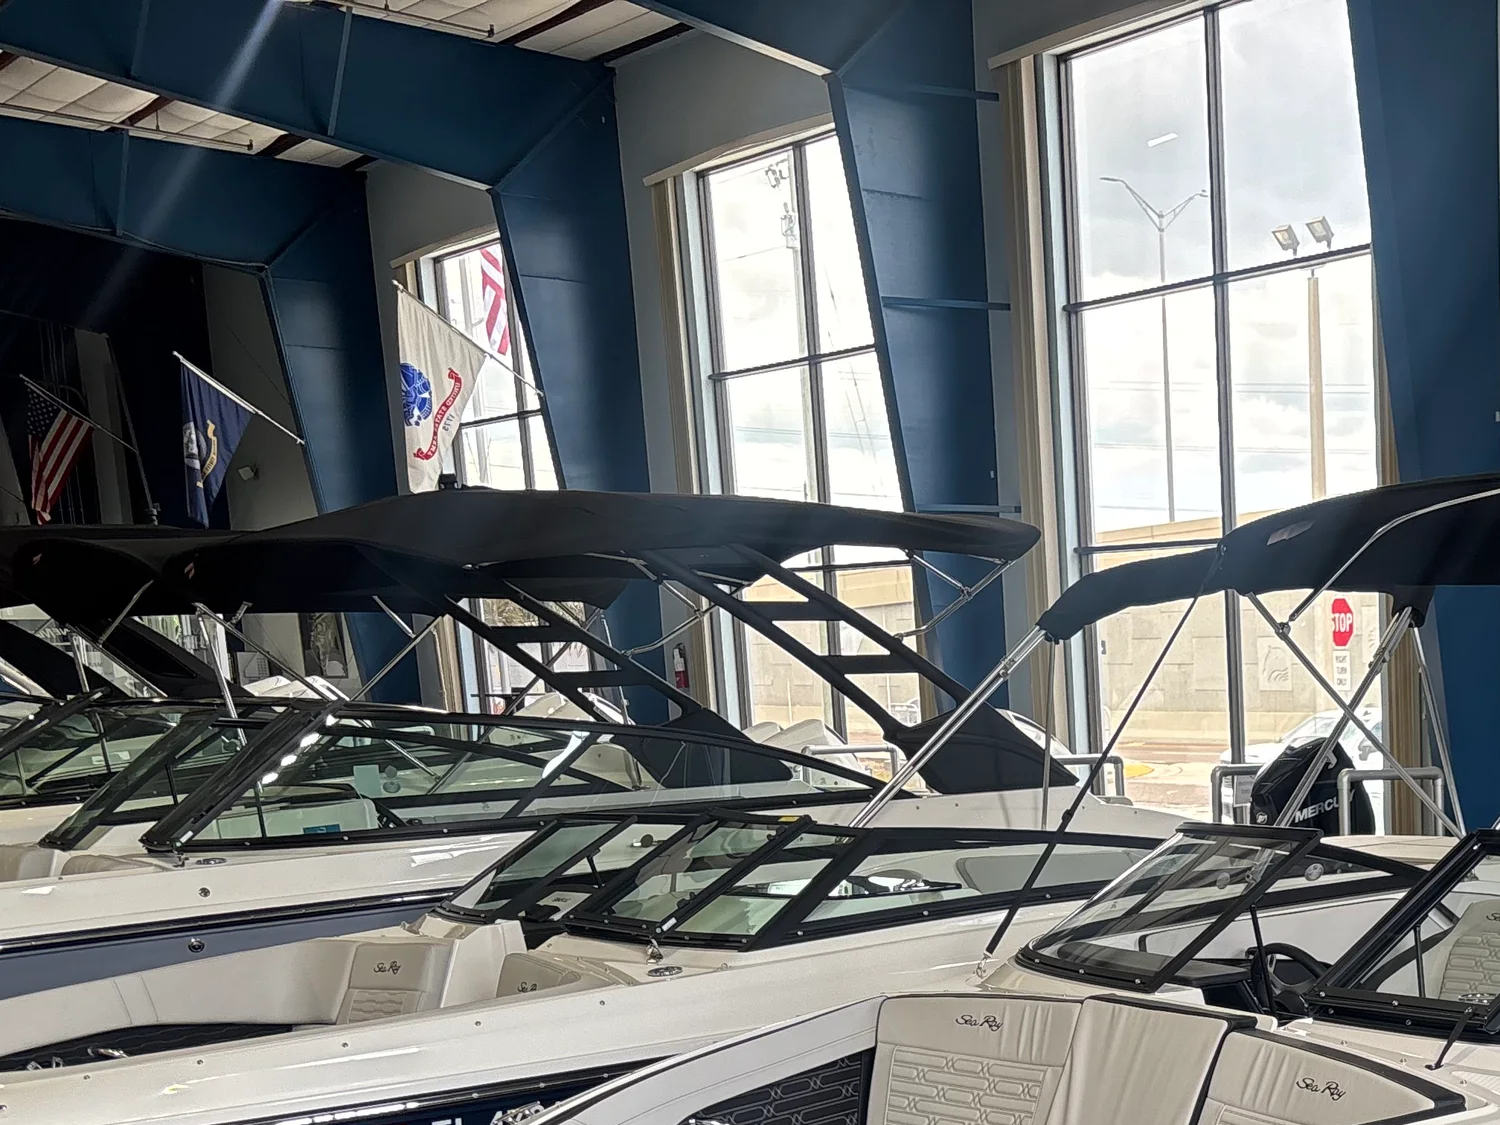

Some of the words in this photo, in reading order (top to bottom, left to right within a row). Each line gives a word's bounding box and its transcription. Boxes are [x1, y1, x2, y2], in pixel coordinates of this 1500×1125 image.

[1331, 613, 1353, 633] STOP
[1294, 789, 1355, 823] MERCU
[955, 1014, 979, 1026] Sea
[979, 1015, 1003, 1032] Ray
[1296, 1077, 1320, 1092] Sea
[1320, 1081, 1347, 1101] Ray
